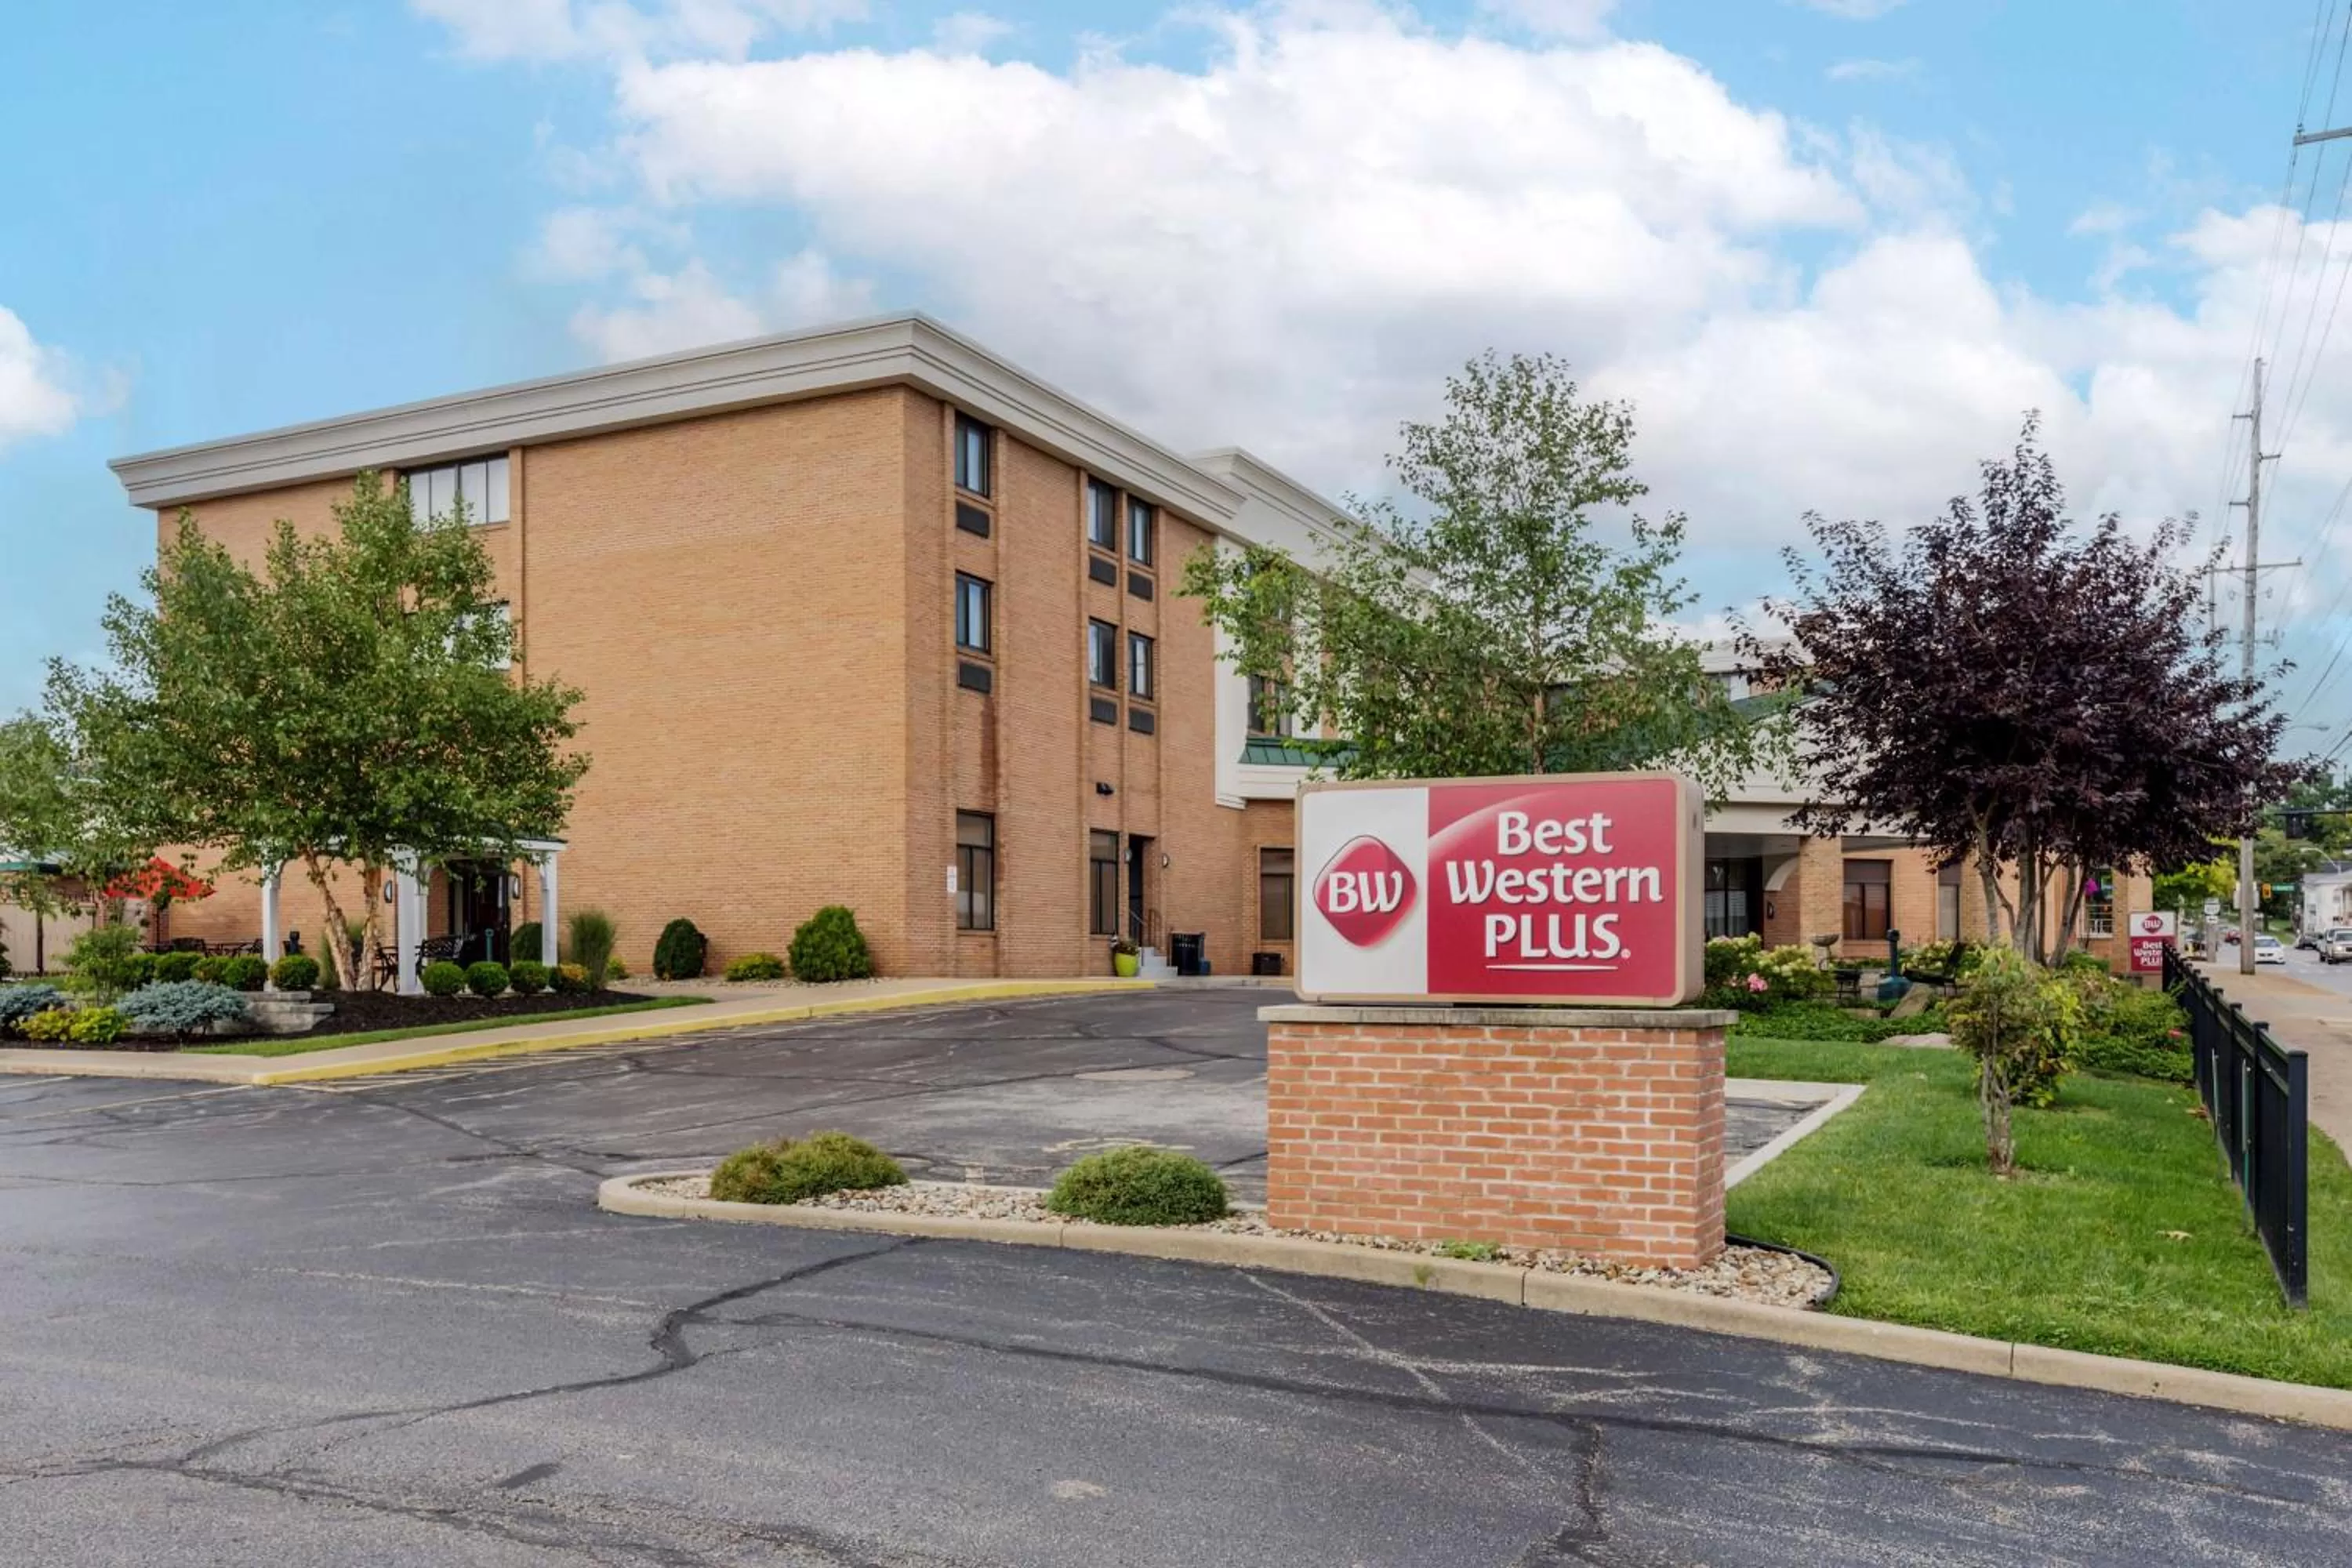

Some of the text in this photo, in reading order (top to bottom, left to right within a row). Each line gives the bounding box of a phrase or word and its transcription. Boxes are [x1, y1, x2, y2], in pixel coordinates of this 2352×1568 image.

[1497, 811, 1613, 855] Best
[1327, 871, 1403, 913] BW
[1446, 860, 1663, 904] Western
